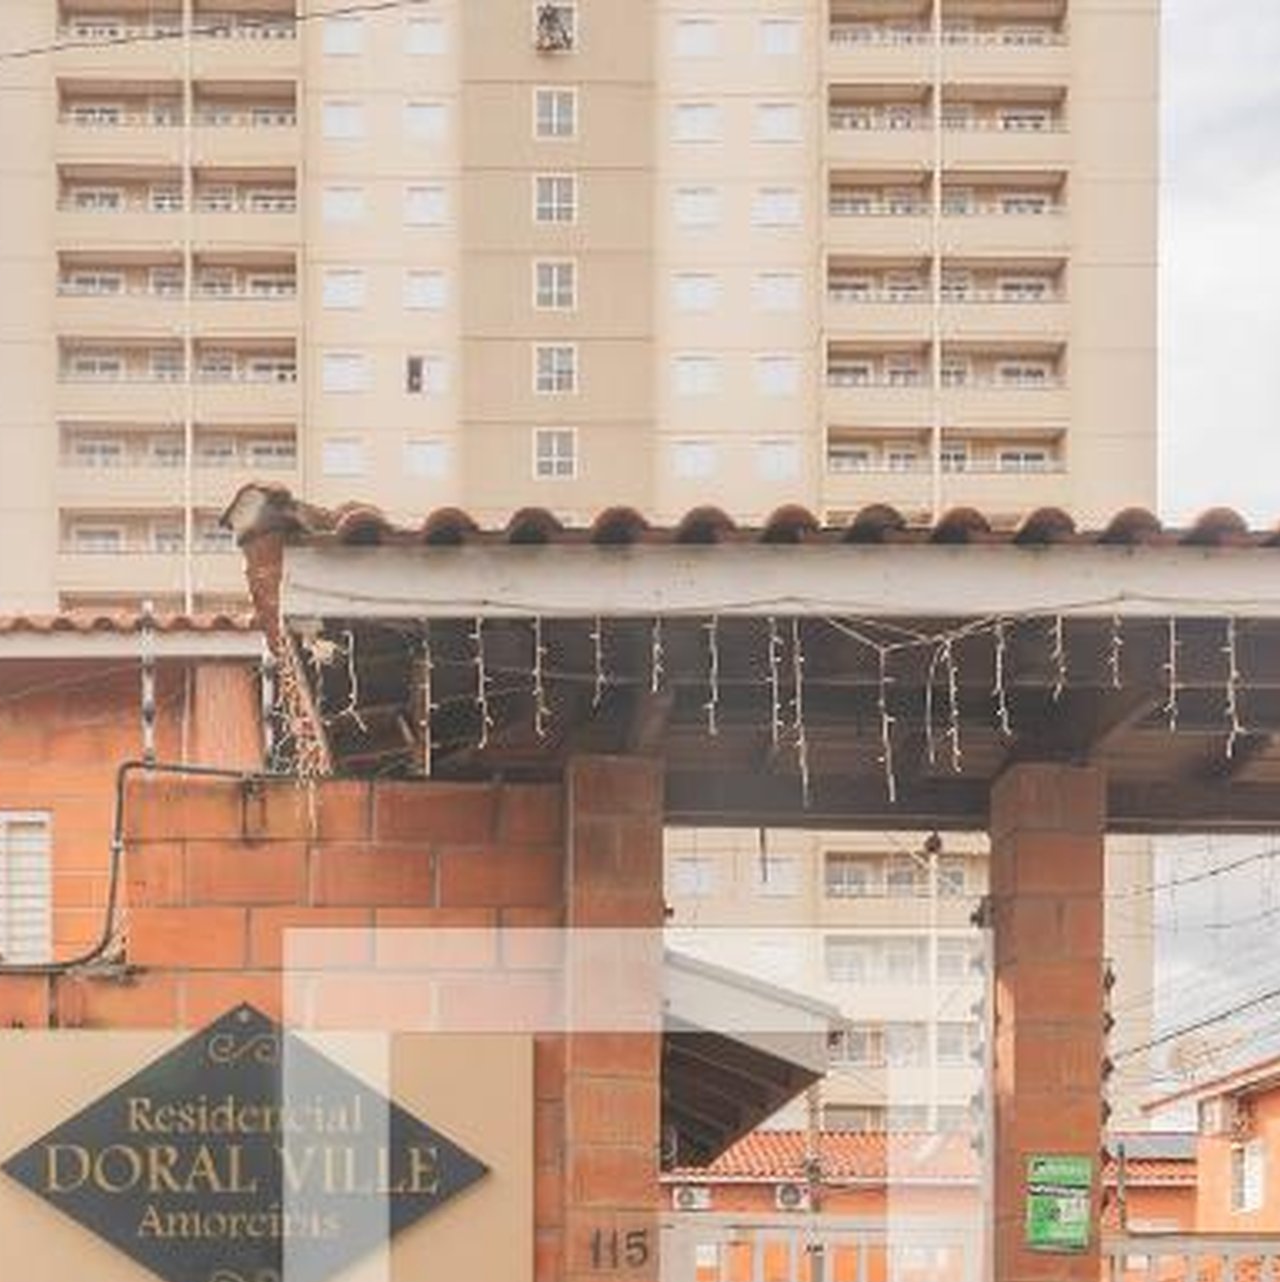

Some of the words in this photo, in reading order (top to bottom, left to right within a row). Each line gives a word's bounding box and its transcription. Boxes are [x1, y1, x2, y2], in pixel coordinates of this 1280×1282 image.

[128, 1095, 363, 1134] Residencial
[46, 1144, 257, 1194] DORAL
[278, 1146, 441, 1194] VILLE
[591, 1227, 649, 1269] 115
